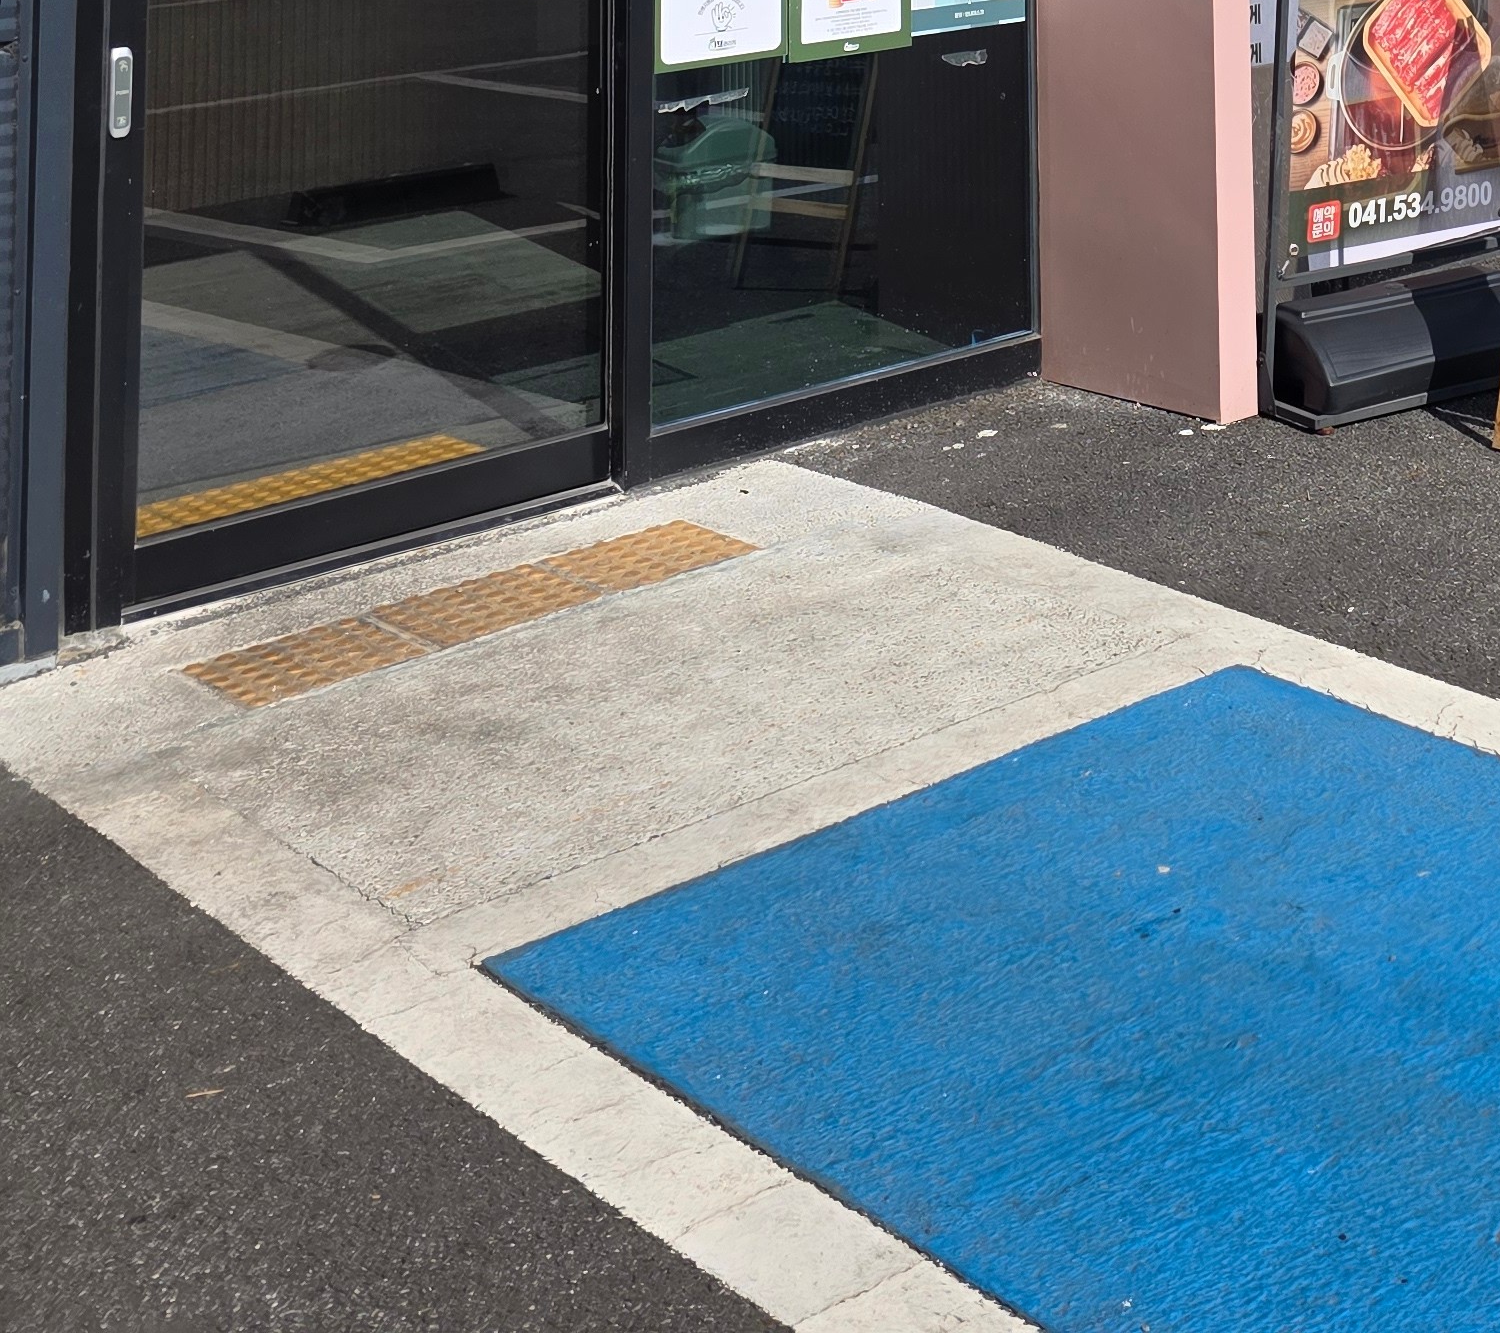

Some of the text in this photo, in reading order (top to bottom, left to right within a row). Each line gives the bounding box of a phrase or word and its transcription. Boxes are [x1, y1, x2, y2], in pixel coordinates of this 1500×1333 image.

[1312, 181, 1493, 229] 예약 041.534.9800
[1311, 220, 1335, 239] 문의
